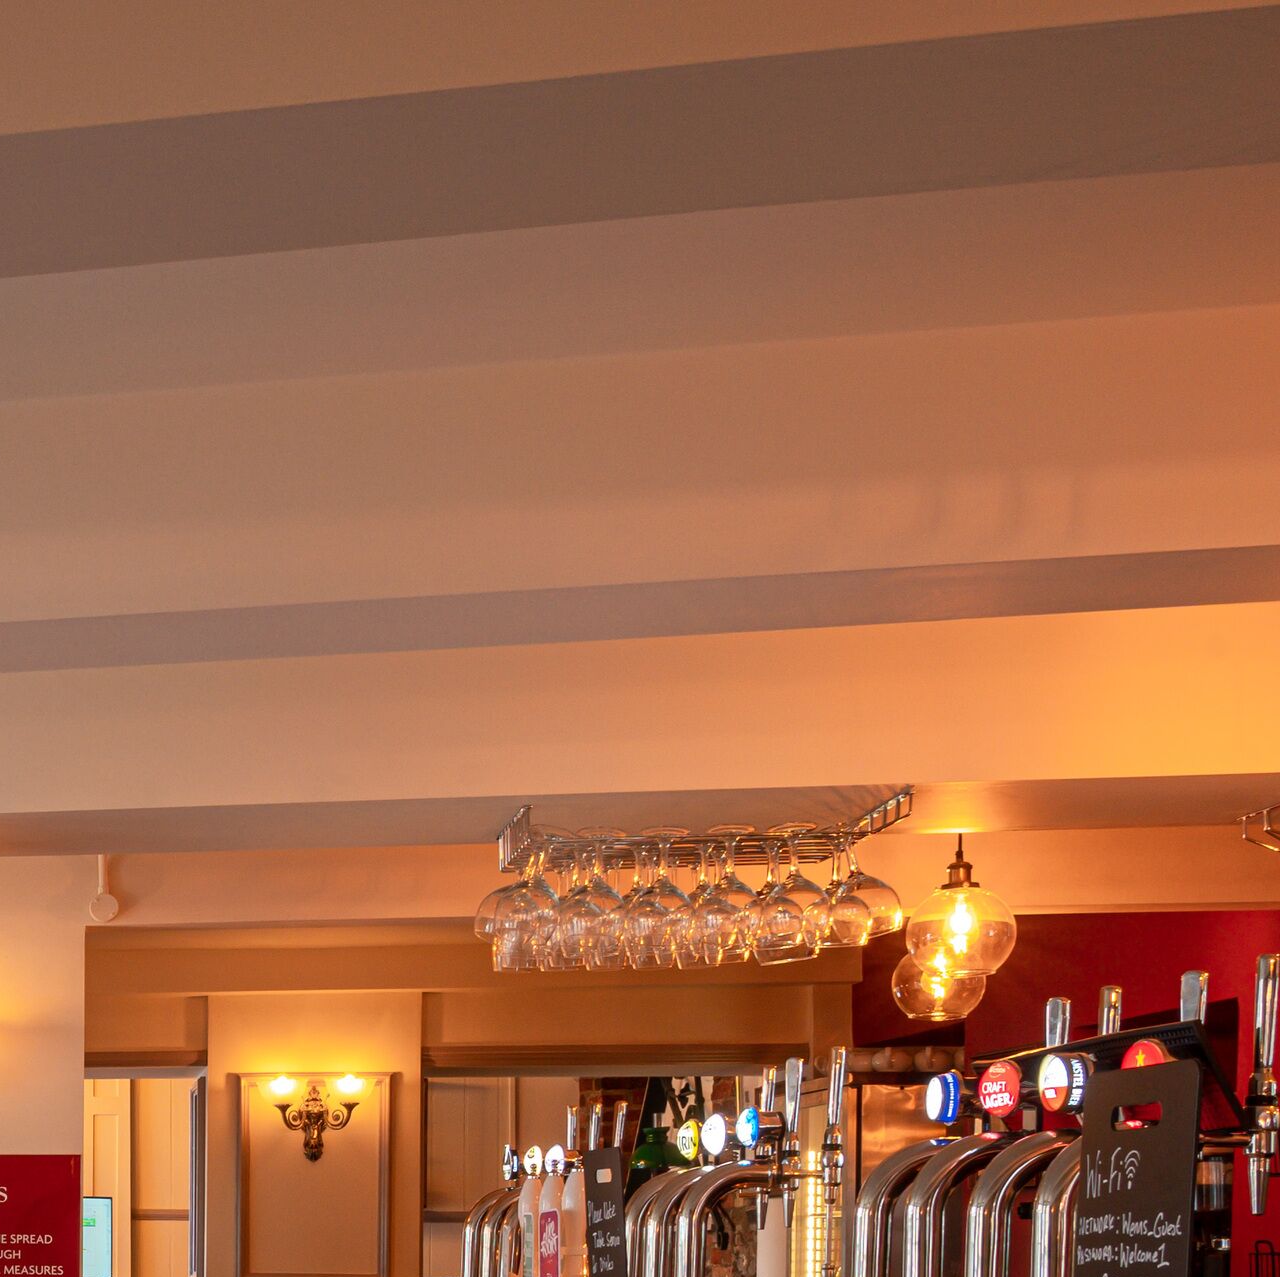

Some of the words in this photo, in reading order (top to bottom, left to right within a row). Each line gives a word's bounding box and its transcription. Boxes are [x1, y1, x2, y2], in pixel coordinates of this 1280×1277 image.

[1069, 1058, 1084, 1088] AMSTEL
[982, 1081, 1006, 1094] CRAFT
[1067, 1088, 1084, 1106] BIER
[1086, 1147, 1123, 1199] Wi-Fi
[10, 1234, 53, 1245] SPREAD
[3, 1265, 64, 1276] MEASURES
